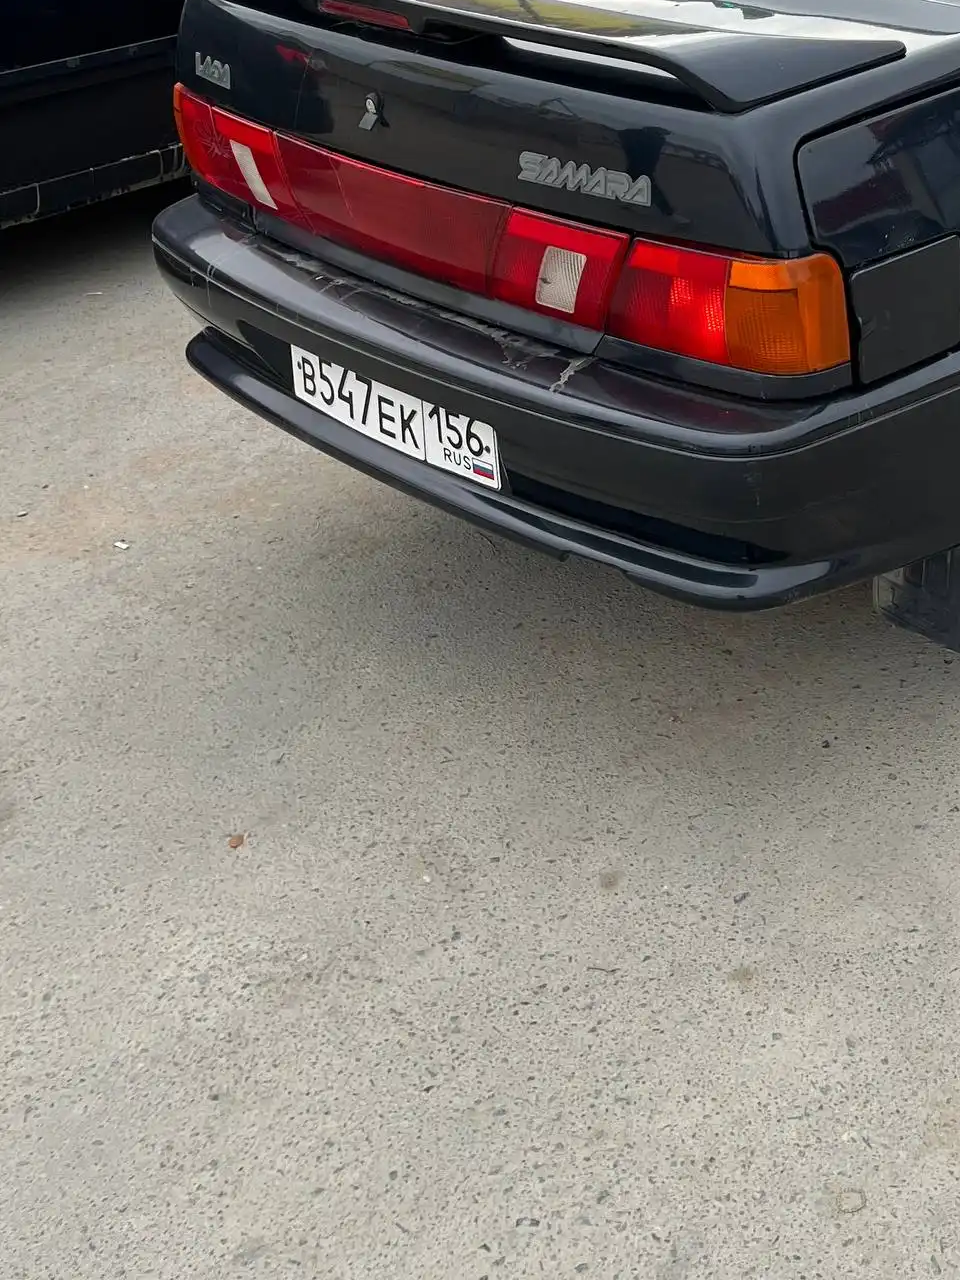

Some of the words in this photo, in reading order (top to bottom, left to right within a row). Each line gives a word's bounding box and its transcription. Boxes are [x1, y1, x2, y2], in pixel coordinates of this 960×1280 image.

[518, 151, 651, 207] SAMARA
[428, 404, 485, 457] 156
[443, 447, 471, 471] RUS
